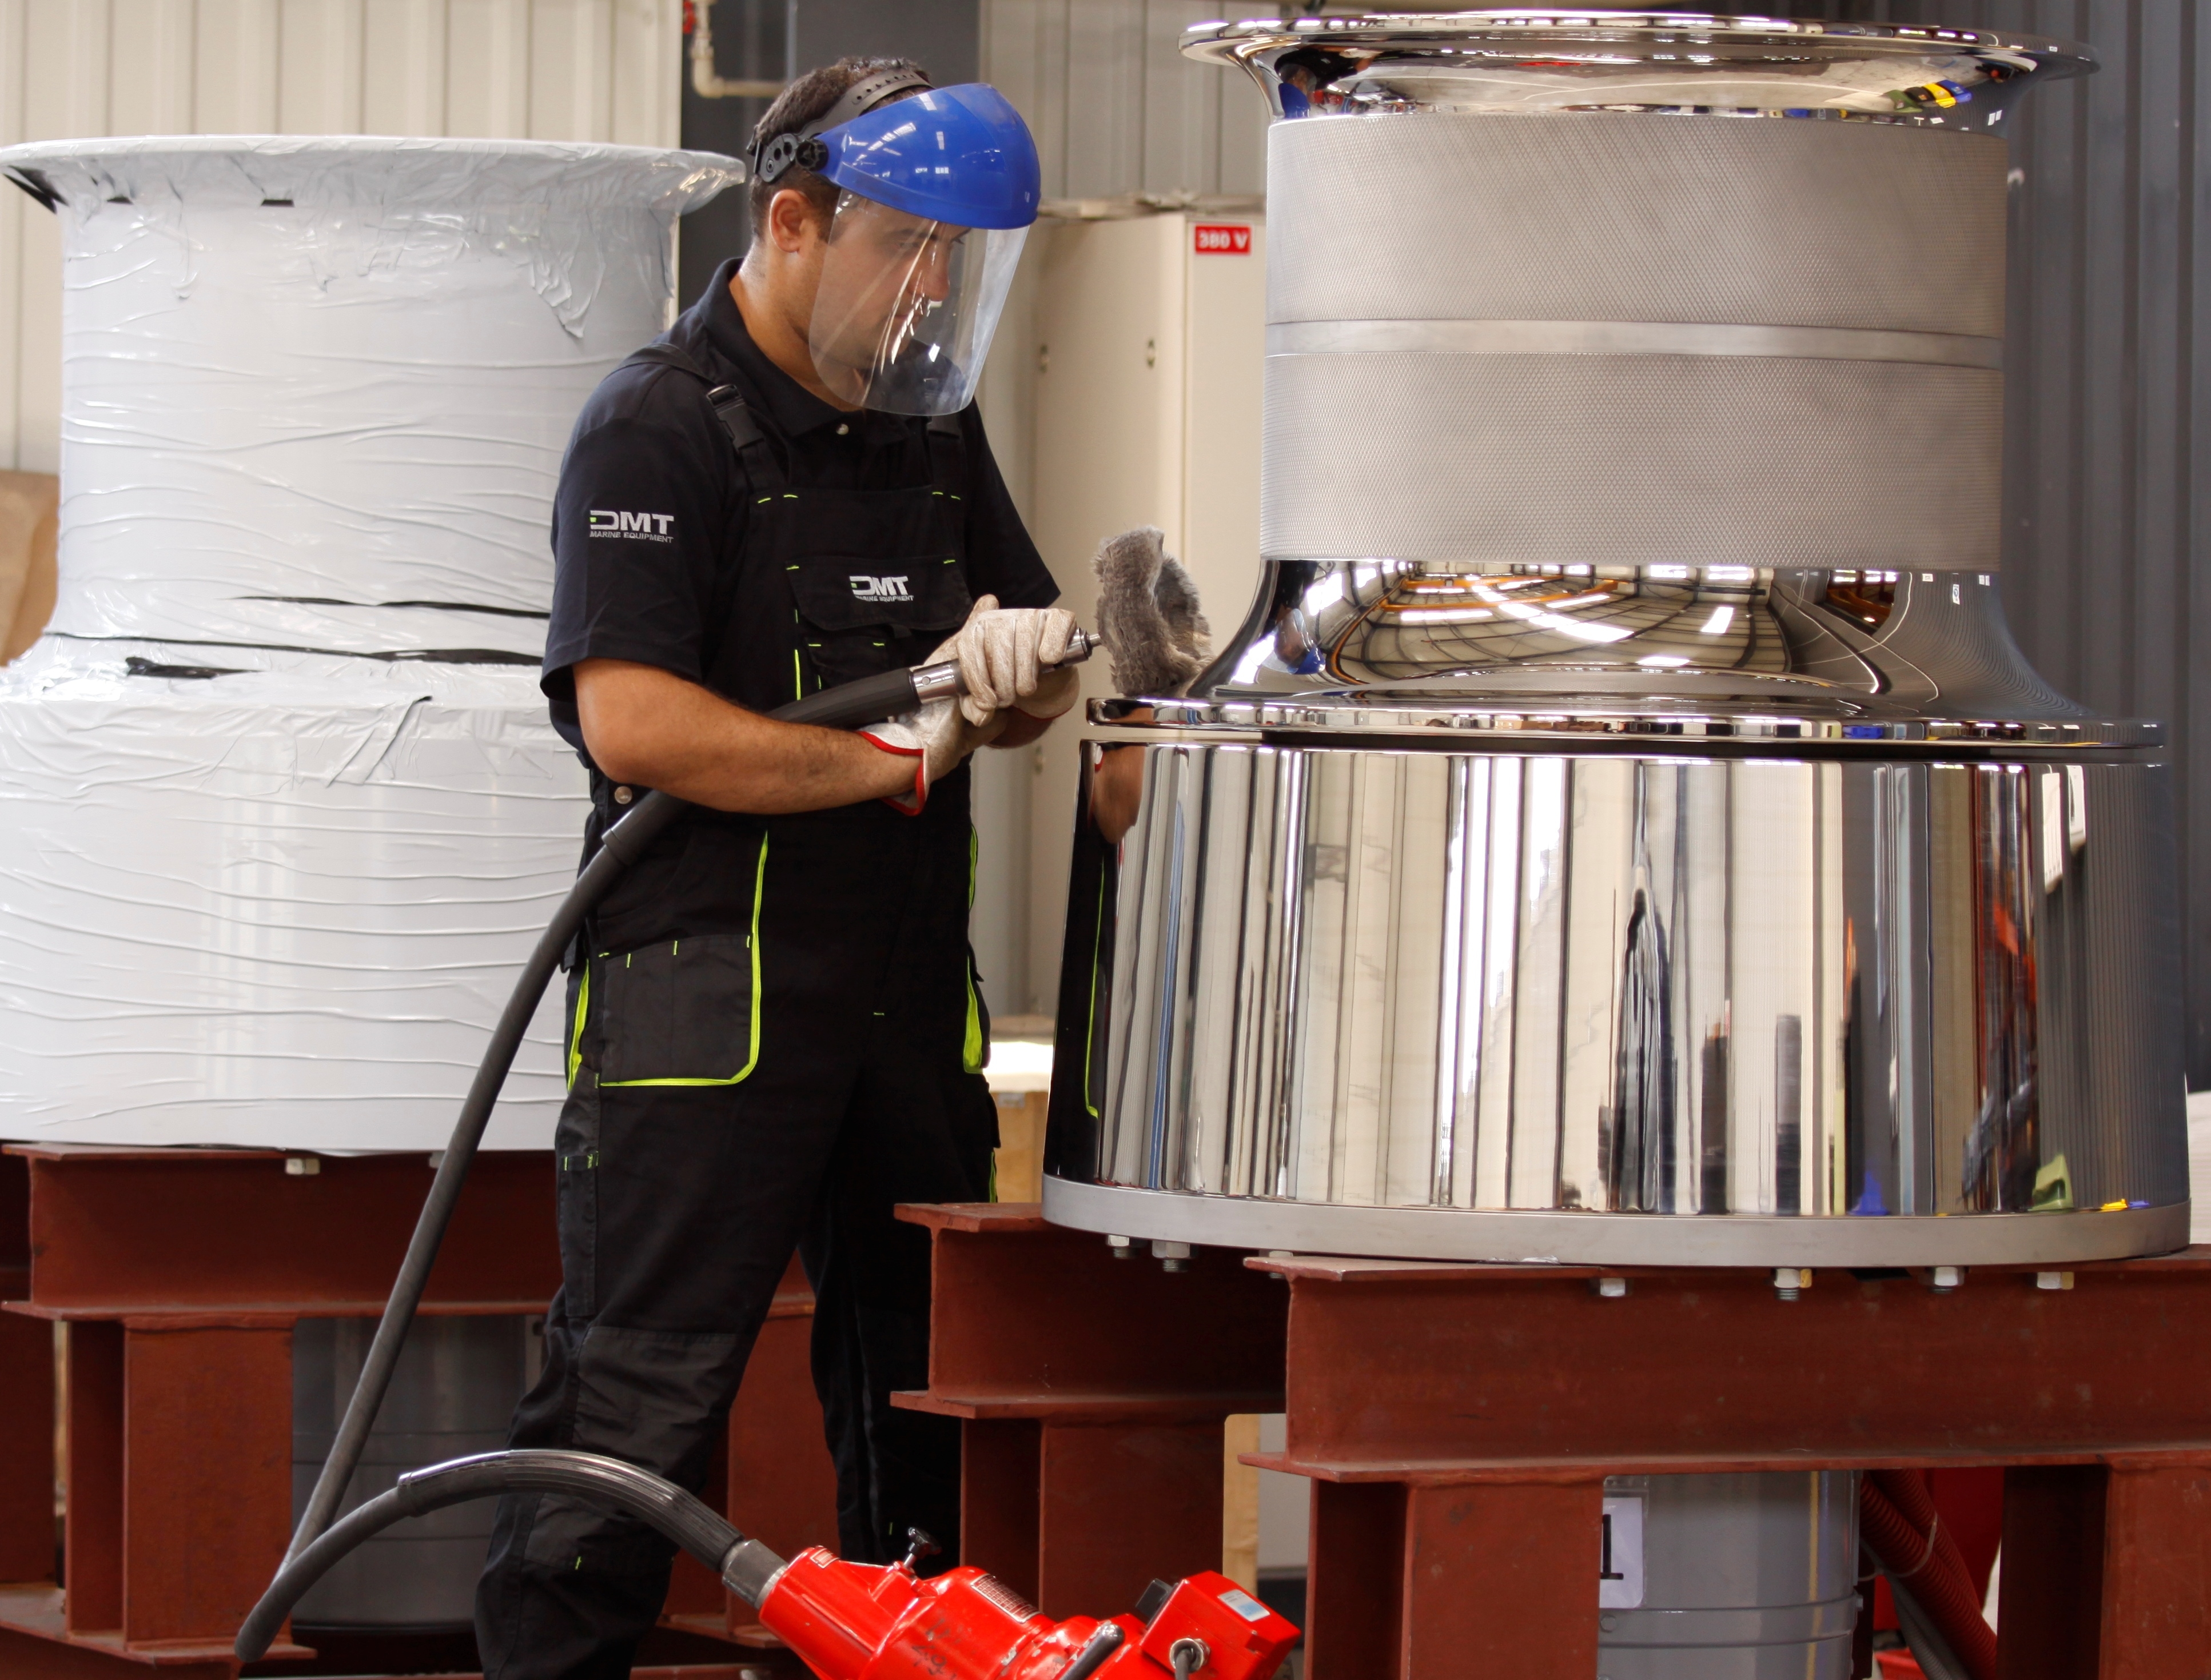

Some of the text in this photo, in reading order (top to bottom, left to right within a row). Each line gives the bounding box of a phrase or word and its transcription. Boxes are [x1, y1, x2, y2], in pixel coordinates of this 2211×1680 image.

[1198, 229, 1249, 250] 380 V
[589, 510, 675, 535] DMT
[623, 532, 674, 544] EQUIPMENT
[849, 576, 909, 596] DMT
